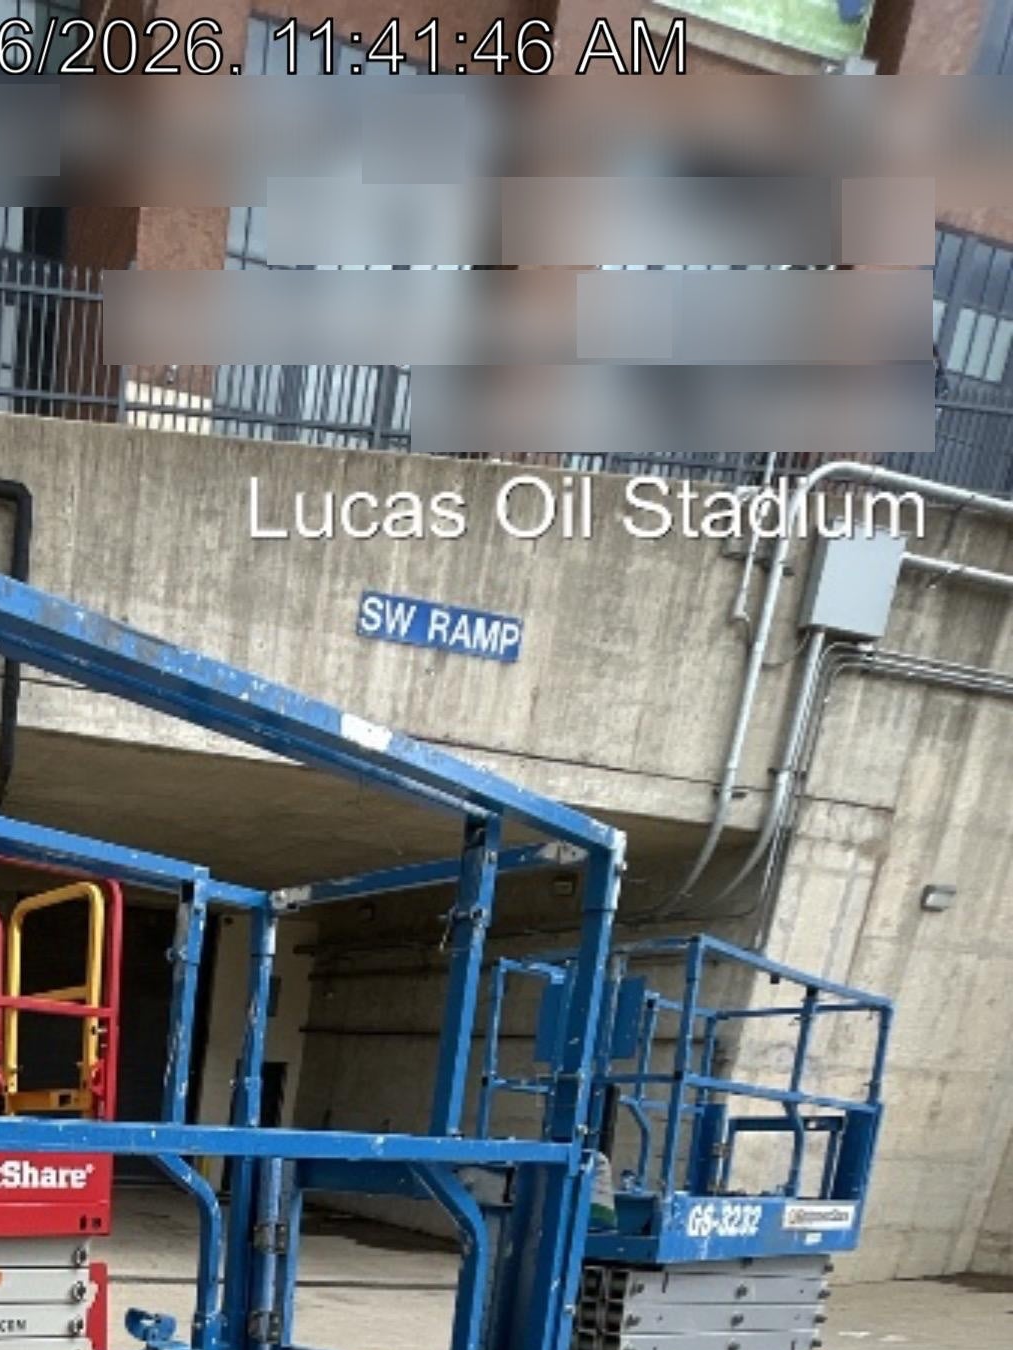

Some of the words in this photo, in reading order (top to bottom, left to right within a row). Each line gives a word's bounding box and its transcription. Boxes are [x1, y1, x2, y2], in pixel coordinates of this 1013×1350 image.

[361, 597, 414, 637] SW
[428, 609, 521, 656] RAMP
[687, 1203, 764, 1237] GS-3232
